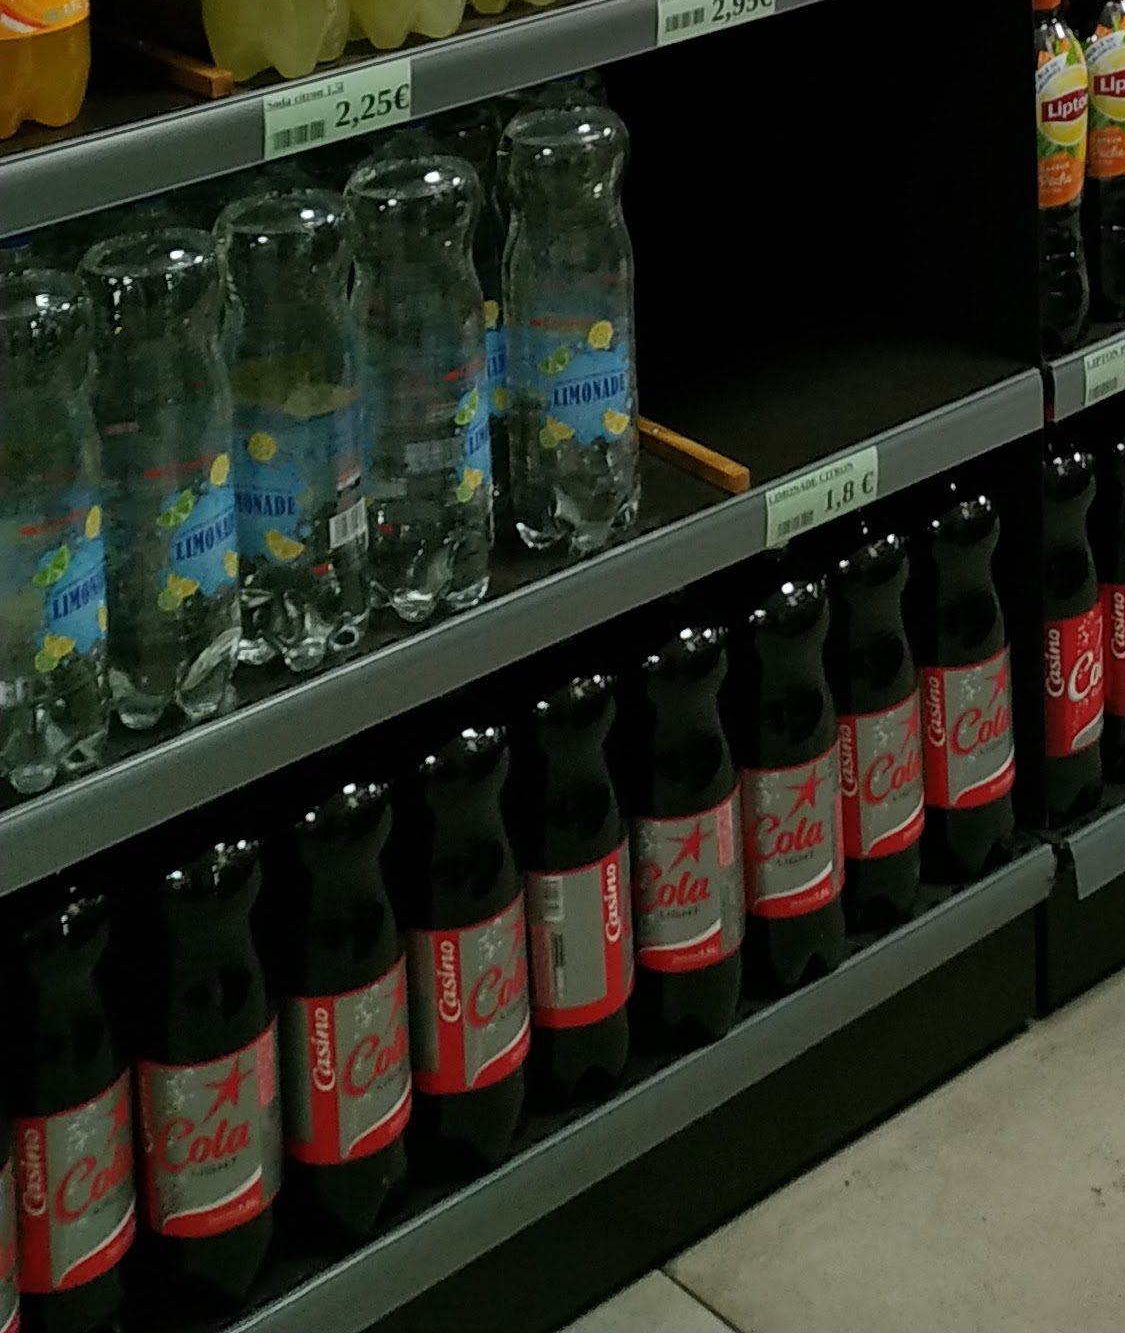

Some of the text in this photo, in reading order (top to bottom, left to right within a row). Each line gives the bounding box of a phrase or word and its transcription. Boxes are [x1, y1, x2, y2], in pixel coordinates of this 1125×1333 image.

[334, 83, 410, 129] 2,25€
[553, 370, 627, 408] LIMONADE
[1046, 628, 1065, 698] Casino
[928, 676, 946, 749] Casino
[840, 724, 860, 798] Casino
[748, 813, 824, 865] Cola
[604, 862, 621, 943] Casino
[437, 939, 462, 1024] Casino
[312, 1005, 336, 1092] Casino
[22, 1127, 48, 1216] Casino
[157, 1116, 251, 1175] Cola
